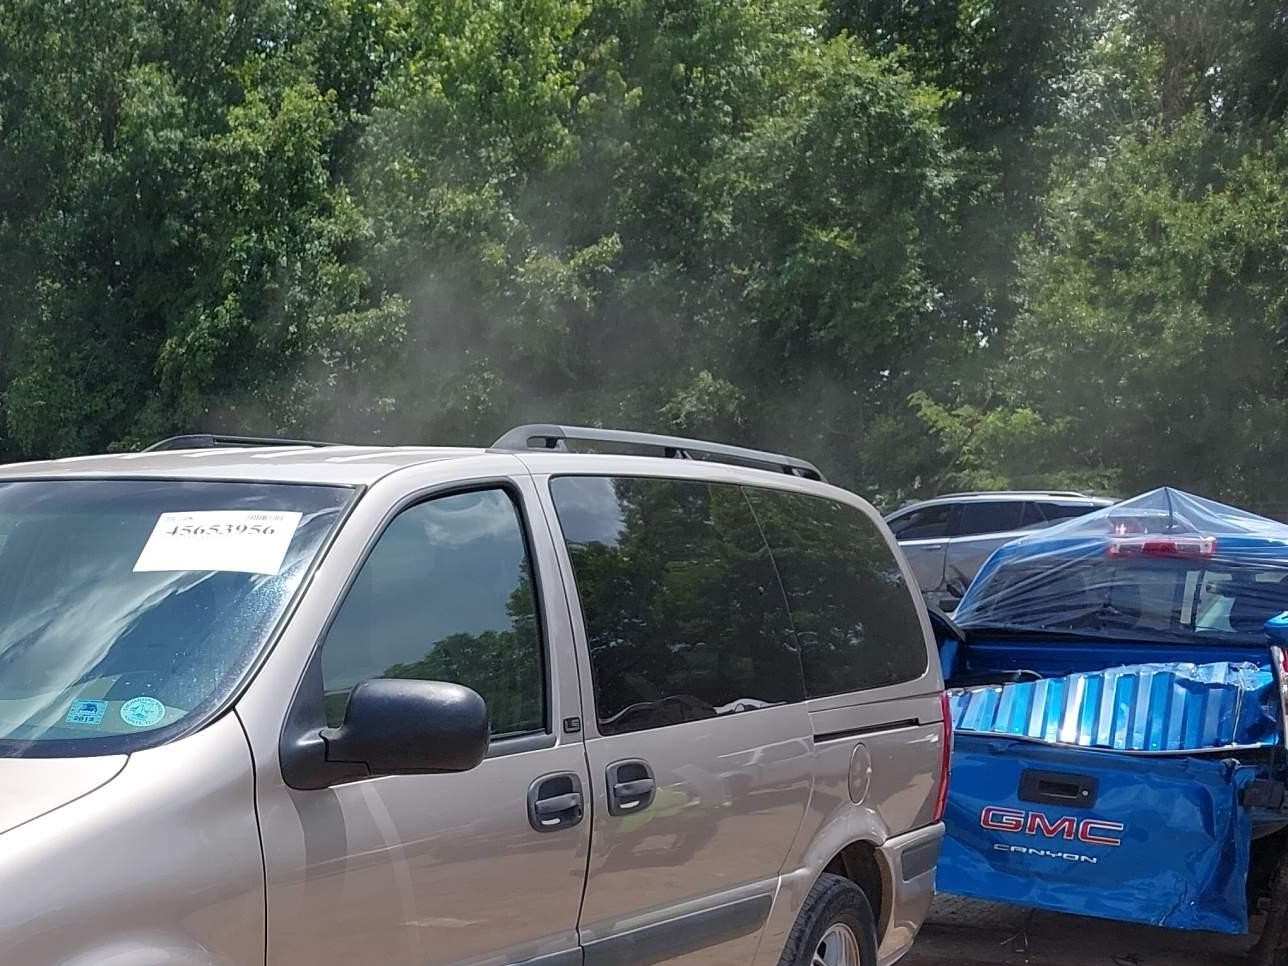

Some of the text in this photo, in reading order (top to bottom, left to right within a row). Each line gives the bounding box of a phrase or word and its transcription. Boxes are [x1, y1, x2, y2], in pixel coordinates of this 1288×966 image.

[165, 524, 275, 536] 45653956
[980, 805, 1124, 846] GMC
[993, 843, 1098, 864] CANYON
